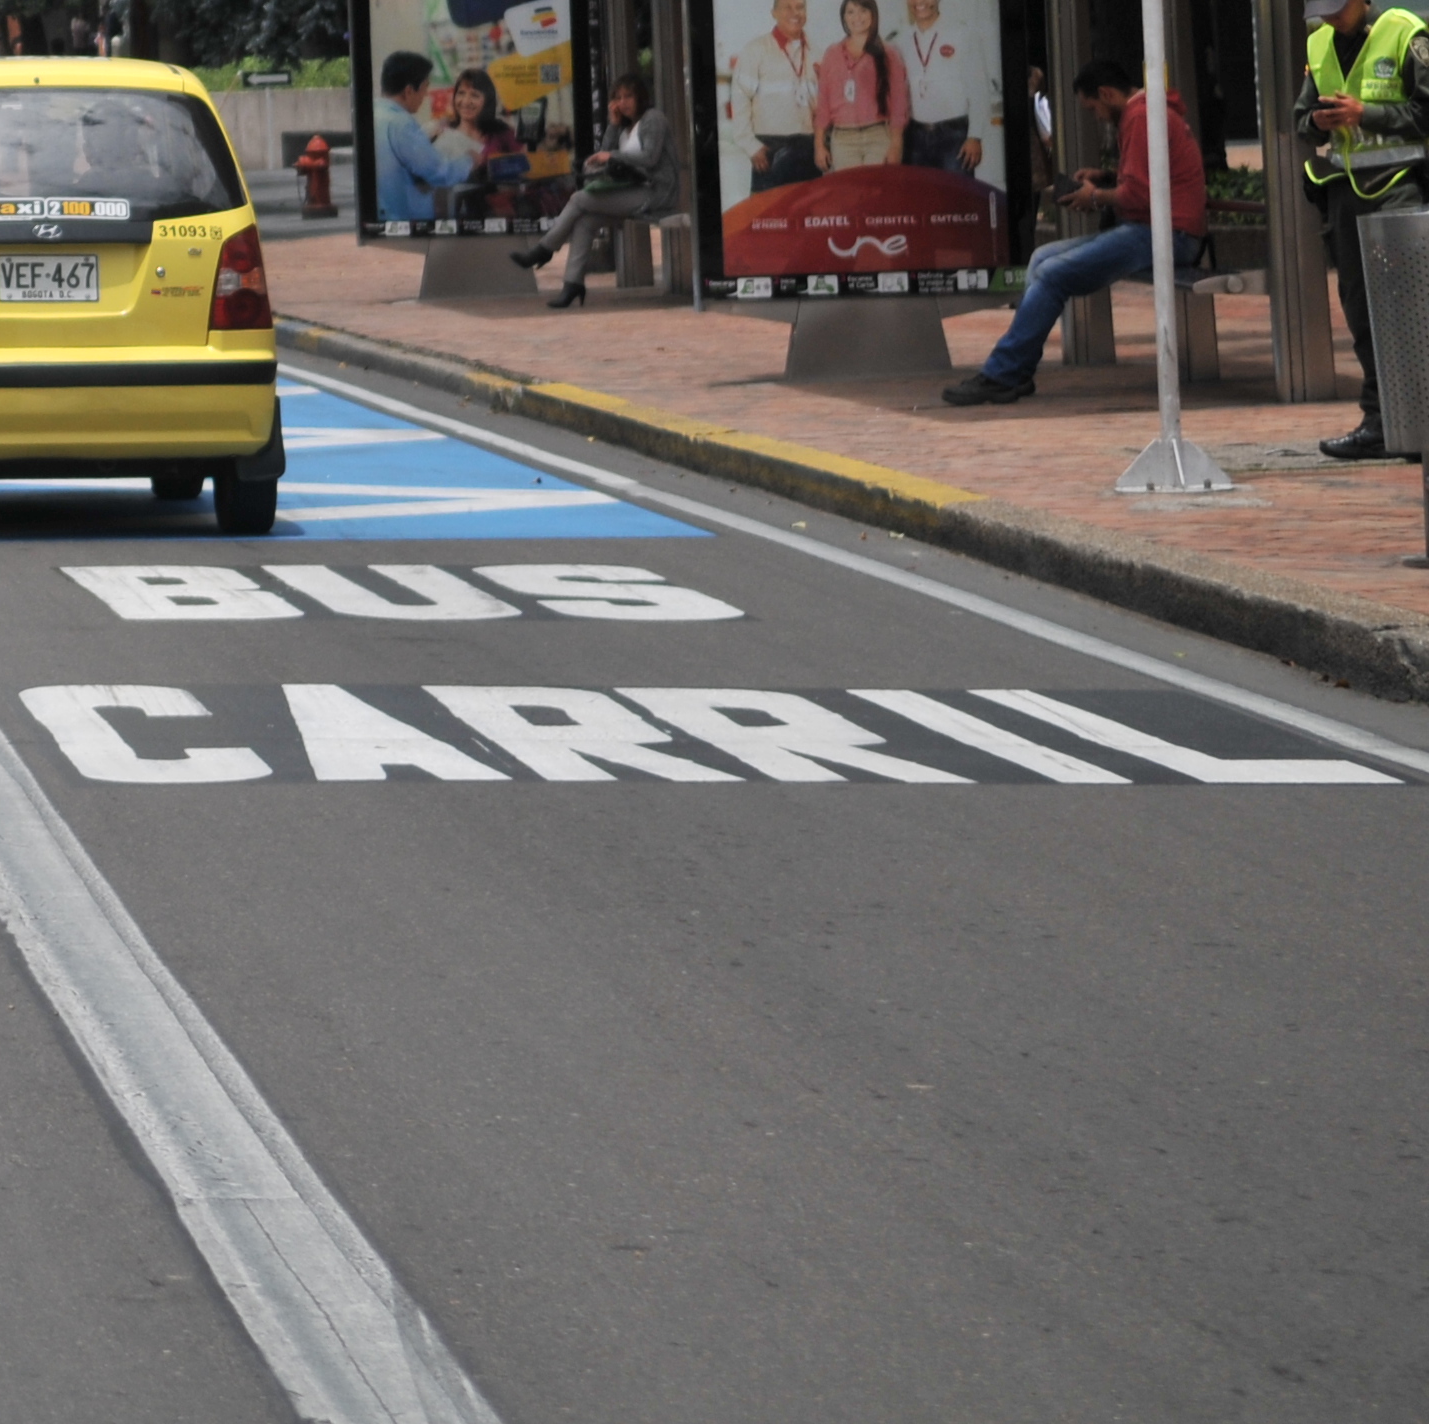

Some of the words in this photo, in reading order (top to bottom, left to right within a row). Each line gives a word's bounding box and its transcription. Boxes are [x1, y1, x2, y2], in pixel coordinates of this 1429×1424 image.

[804, 215, 850, 227] EDATEL
[158, 225, 207, 237] 31093
[21, 290, 54, 299] BOGOTA
[58, 563, 746, 621] BUS
[17, 683, 1407, 784] CARRIL
